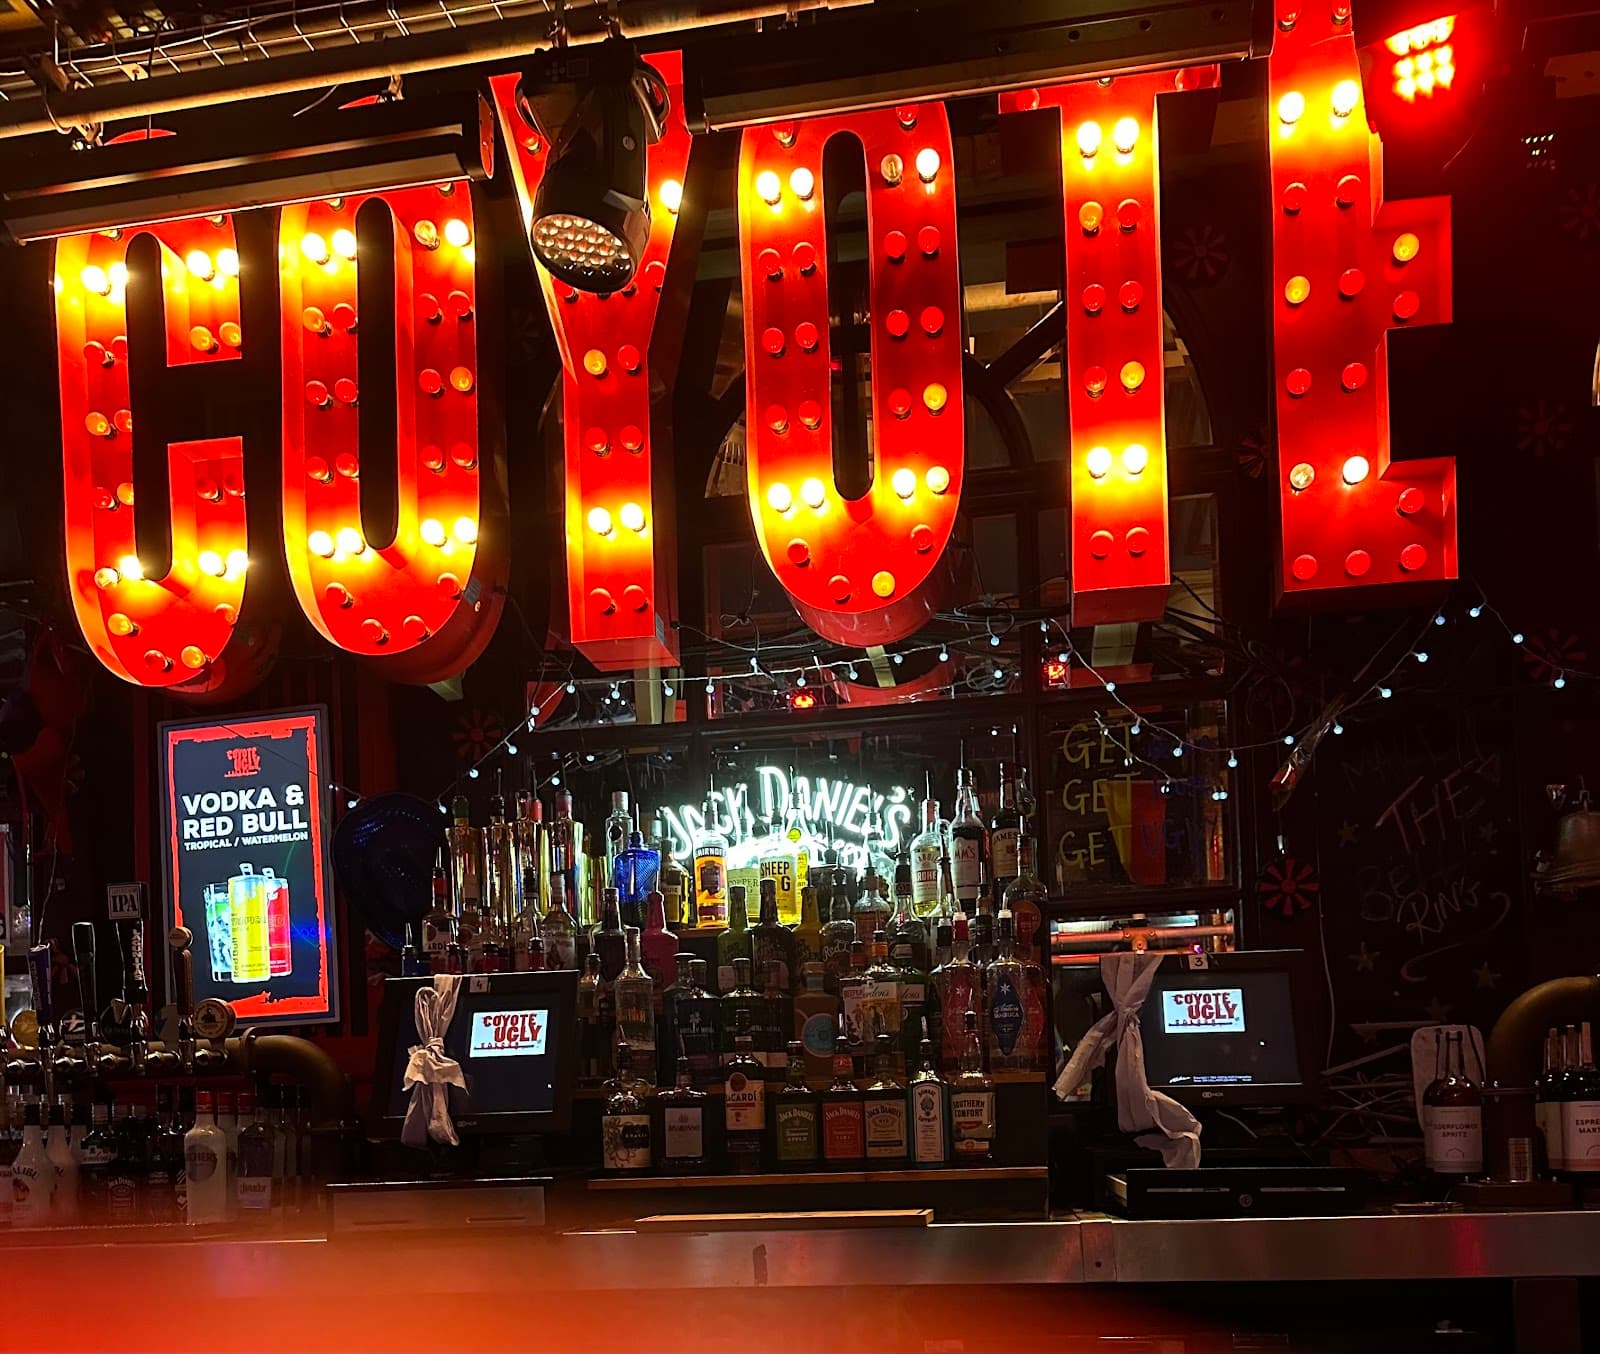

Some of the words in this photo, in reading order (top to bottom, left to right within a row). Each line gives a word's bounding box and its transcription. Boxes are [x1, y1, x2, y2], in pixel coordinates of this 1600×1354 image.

[52, 0, 1459, 687] COYOTE
[1062, 723, 1133, 768] GET
[181, 787, 277, 816] VODKA
[285, 784, 304, 806] &
[1062, 771, 1141, 815] GET
[183, 816, 234, 840] RED
[242, 809, 308, 835] BULL
[184, 838, 233, 851] TROPICAL
[241, 831, 309, 846] WATERMELON
[760, 861, 790, 876] SHEEP
[110, 894, 138, 913] IPA
[1194, 956, 1204, 968] 3
[1172, 992, 1232, 1006] COYOTE
[1188, 1003, 1238, 1020] UGLY
[482, 1013, 538, 1028] COYOTE
[494, 1025, 543, 1042] UGLY
[952, 1099, 985, 1109] SOUTHERN
[954, 1109, 983, 1118] COMFORT
